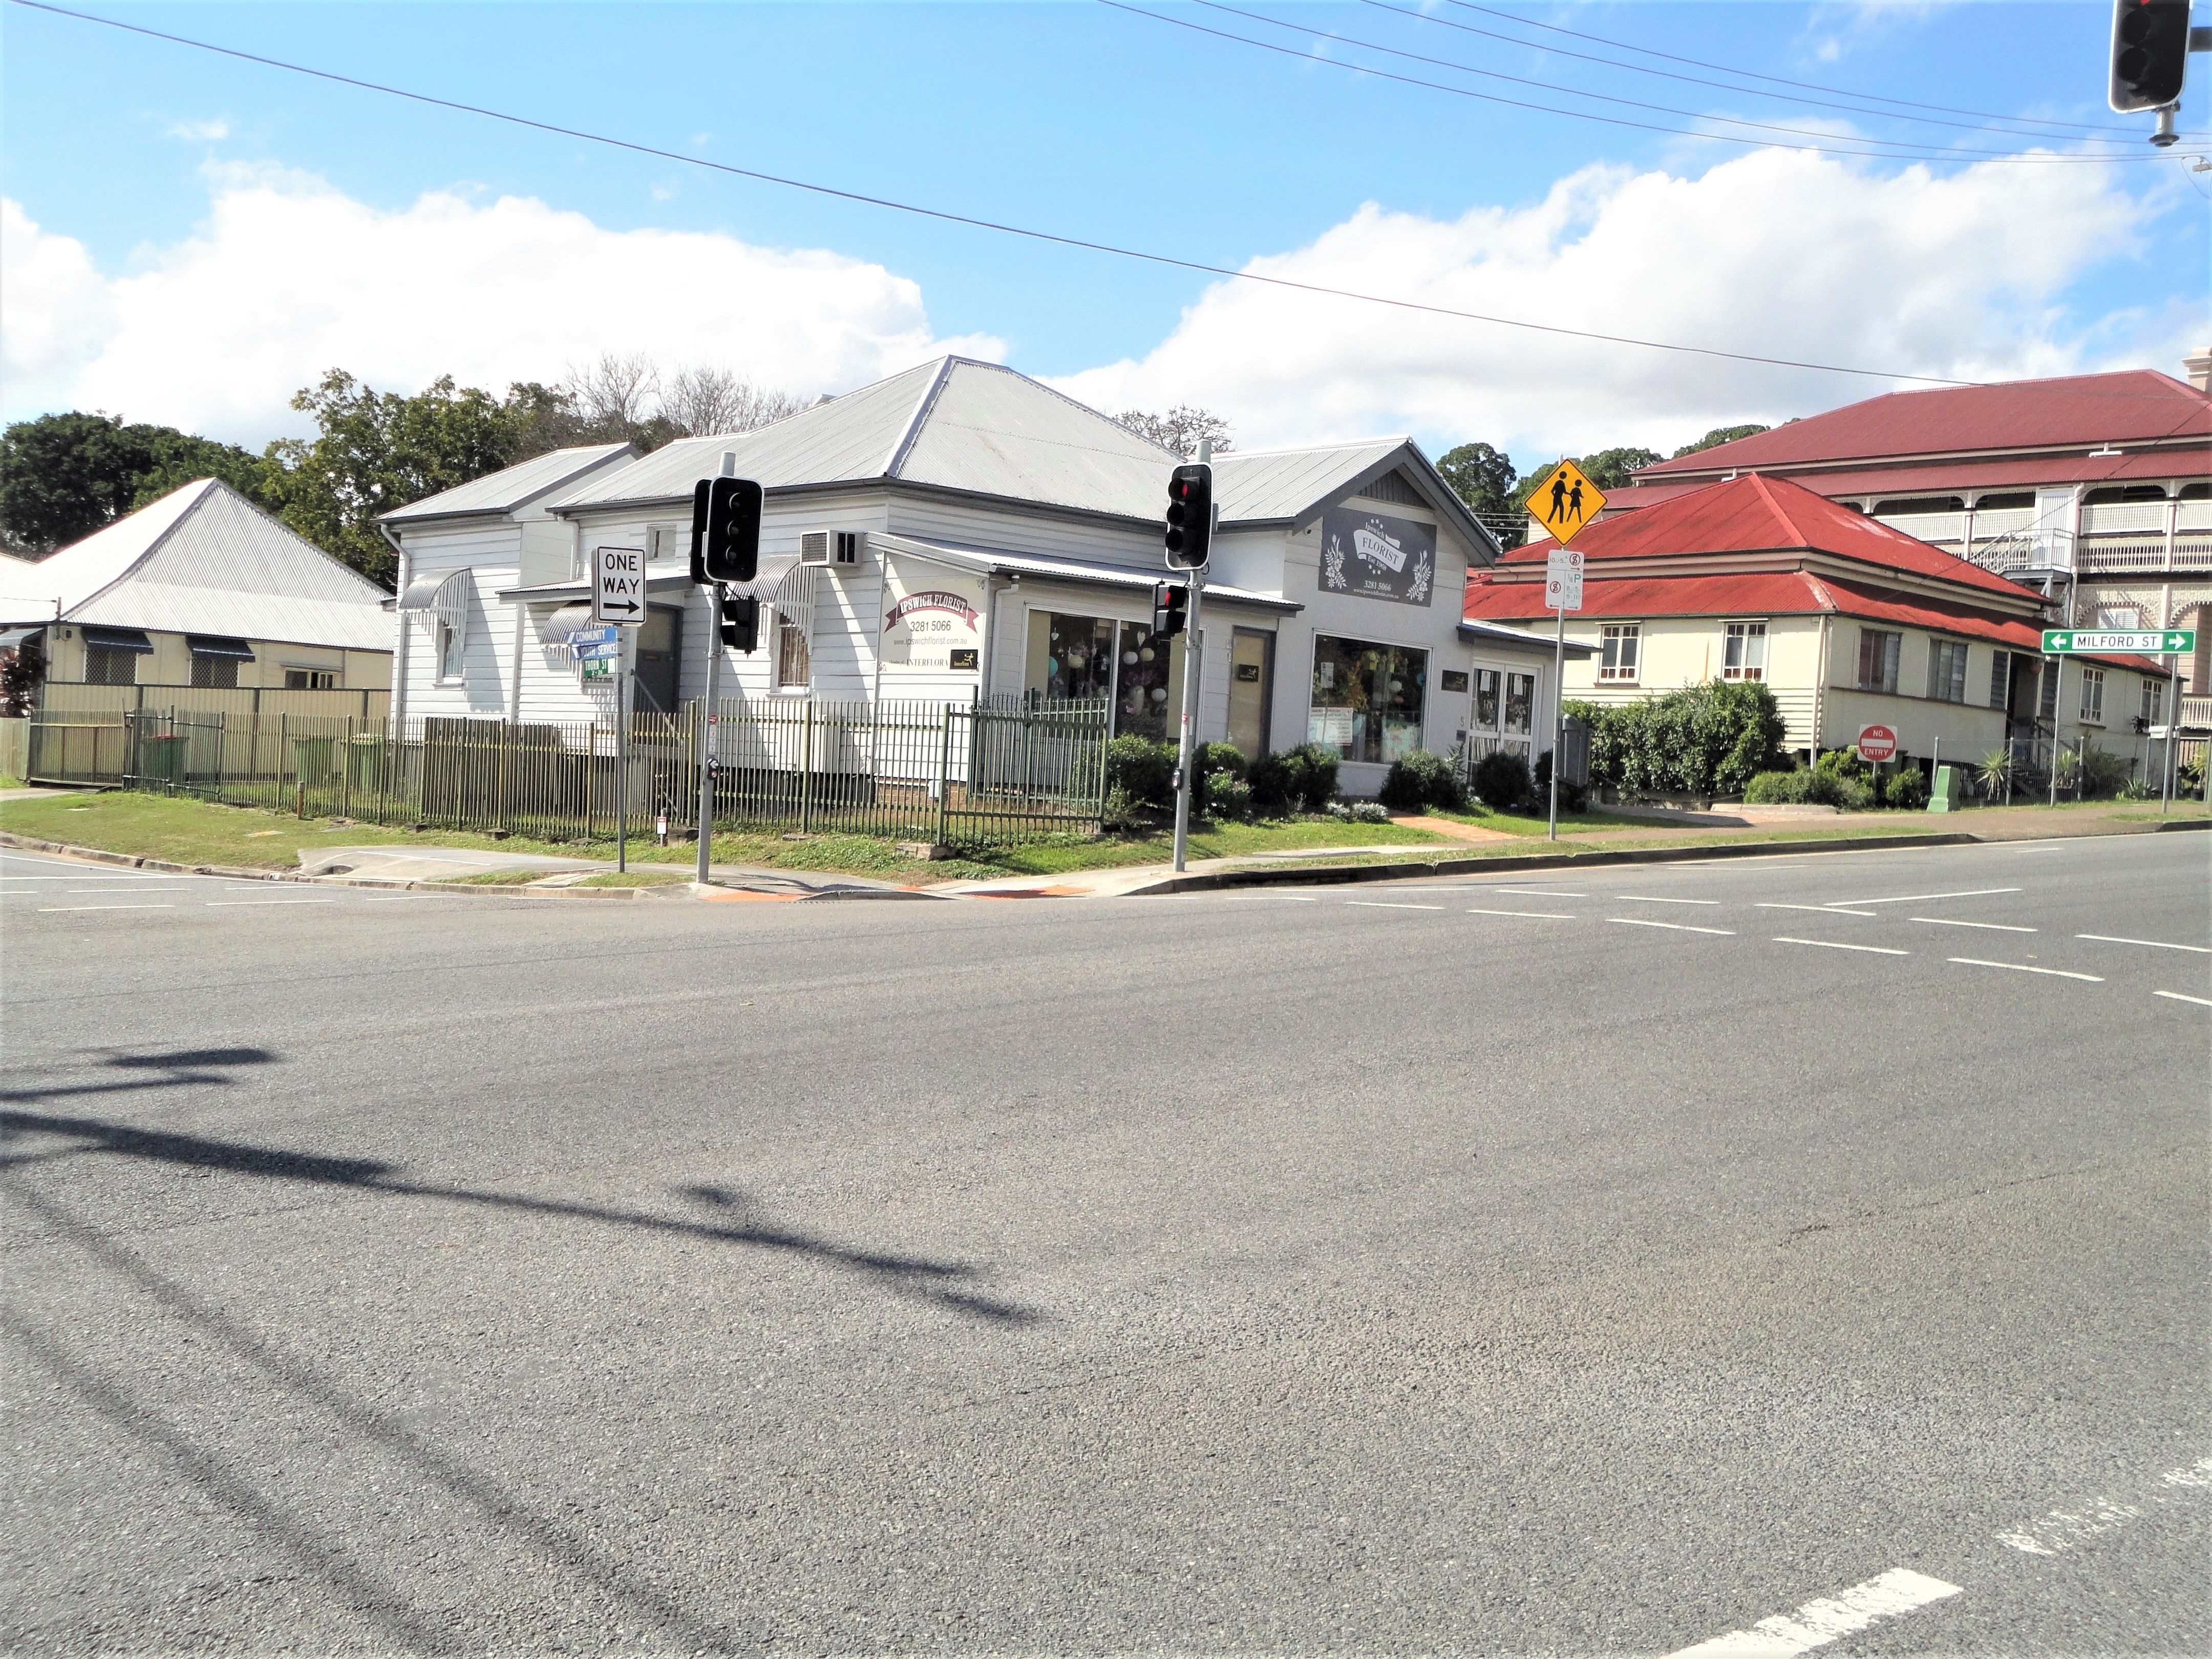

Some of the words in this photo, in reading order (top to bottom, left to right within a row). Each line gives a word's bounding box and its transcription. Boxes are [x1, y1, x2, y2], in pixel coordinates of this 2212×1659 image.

[1363, 537, 1399, 564] FLORIST
[605, 554, 637, 571] ONE
[603, 577, 640, 594] WAY
[1364, 580, 1377, 589] 3281
[1377, 582, 1391, 591] 5066
[900, 594, 932, 613] IPSWICH
[933, 594, 966, 614] FLORIST
[910, 621, 929, 631] 3281
[931, 621, 951, 631] 5066
[576, 629, 605, 642] COMMUNITY
[894, 636, 967, 647] www.ipswichflorist.com.au
[2077, 636, 2134, 647] MILFORD
[2142, 636, 2157, 647] ST
[585, 660, 599, 671] THORN
[602, 658, 607, 670] ST
